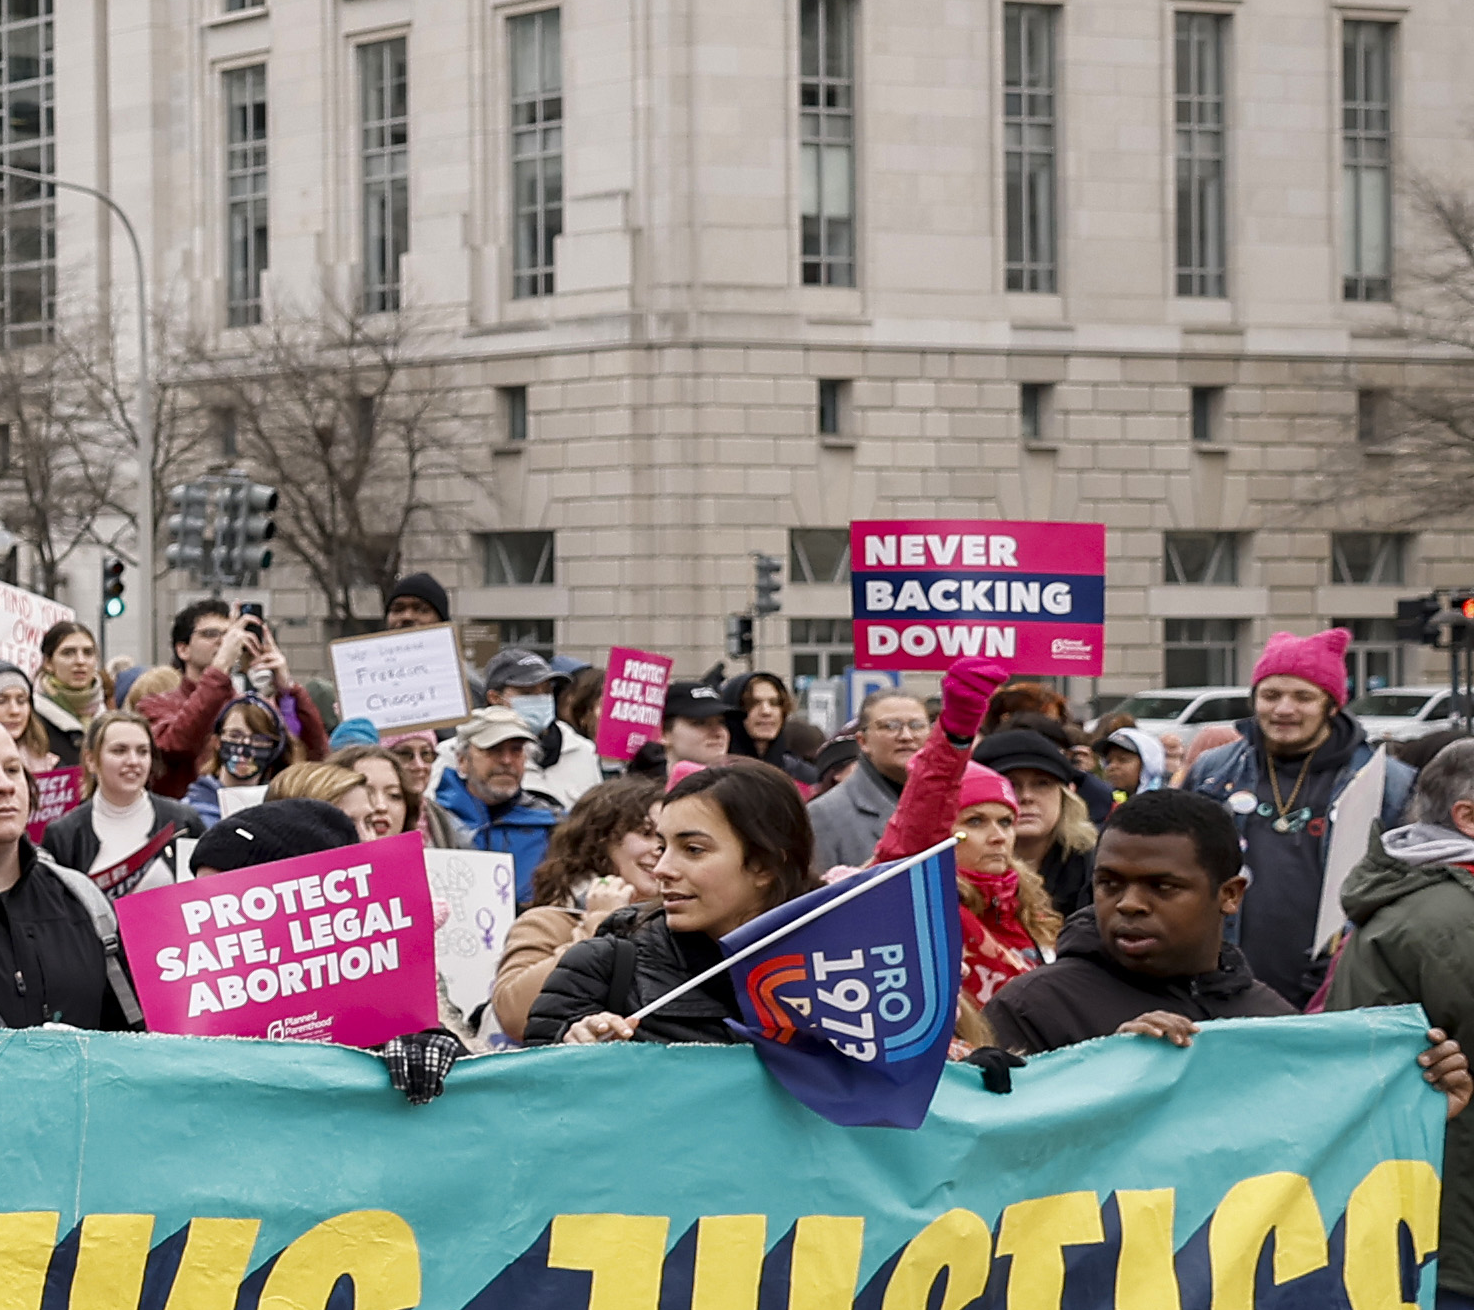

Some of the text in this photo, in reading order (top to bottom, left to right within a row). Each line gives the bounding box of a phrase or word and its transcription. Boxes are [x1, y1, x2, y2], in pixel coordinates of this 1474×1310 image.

[864, 534, 1019, 567] NEVER
[865, 579, 1073, 615] BACKING
[866, 625, 1017, 658] DOWN
[180, 862, 373, 935] PROTECT
[155, 928, 281, 983] SAFE,
[288, 896, 413, 954] LEGAL
[187, 937, 400, 1018] ABORTION
[811, 948, 878, 1063] 1973
[870, 943, 913, 1023] PRO
